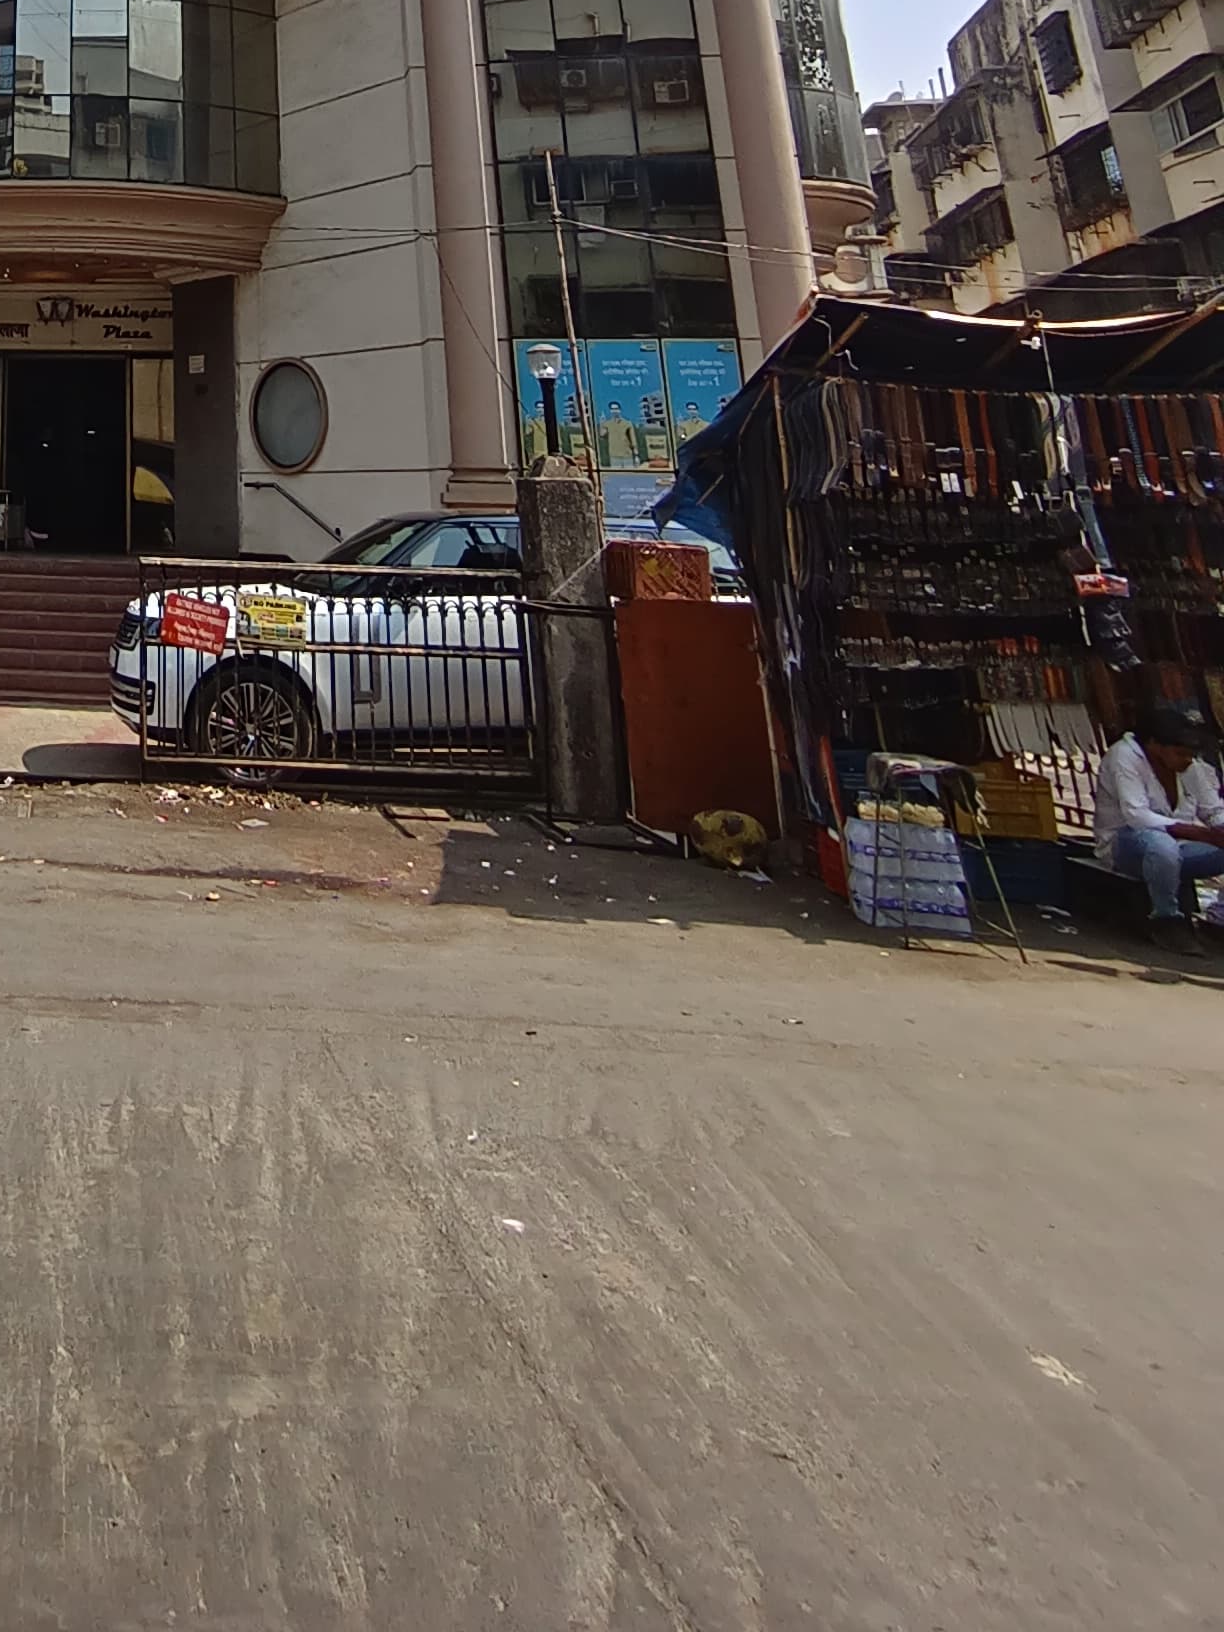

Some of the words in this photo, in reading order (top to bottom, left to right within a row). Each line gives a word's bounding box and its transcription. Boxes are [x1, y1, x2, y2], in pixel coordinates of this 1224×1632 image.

[76, 304, 173, 323] Washington
[102, 324, 153, 339] Plaza
[253, 599, 264, 607] NO
